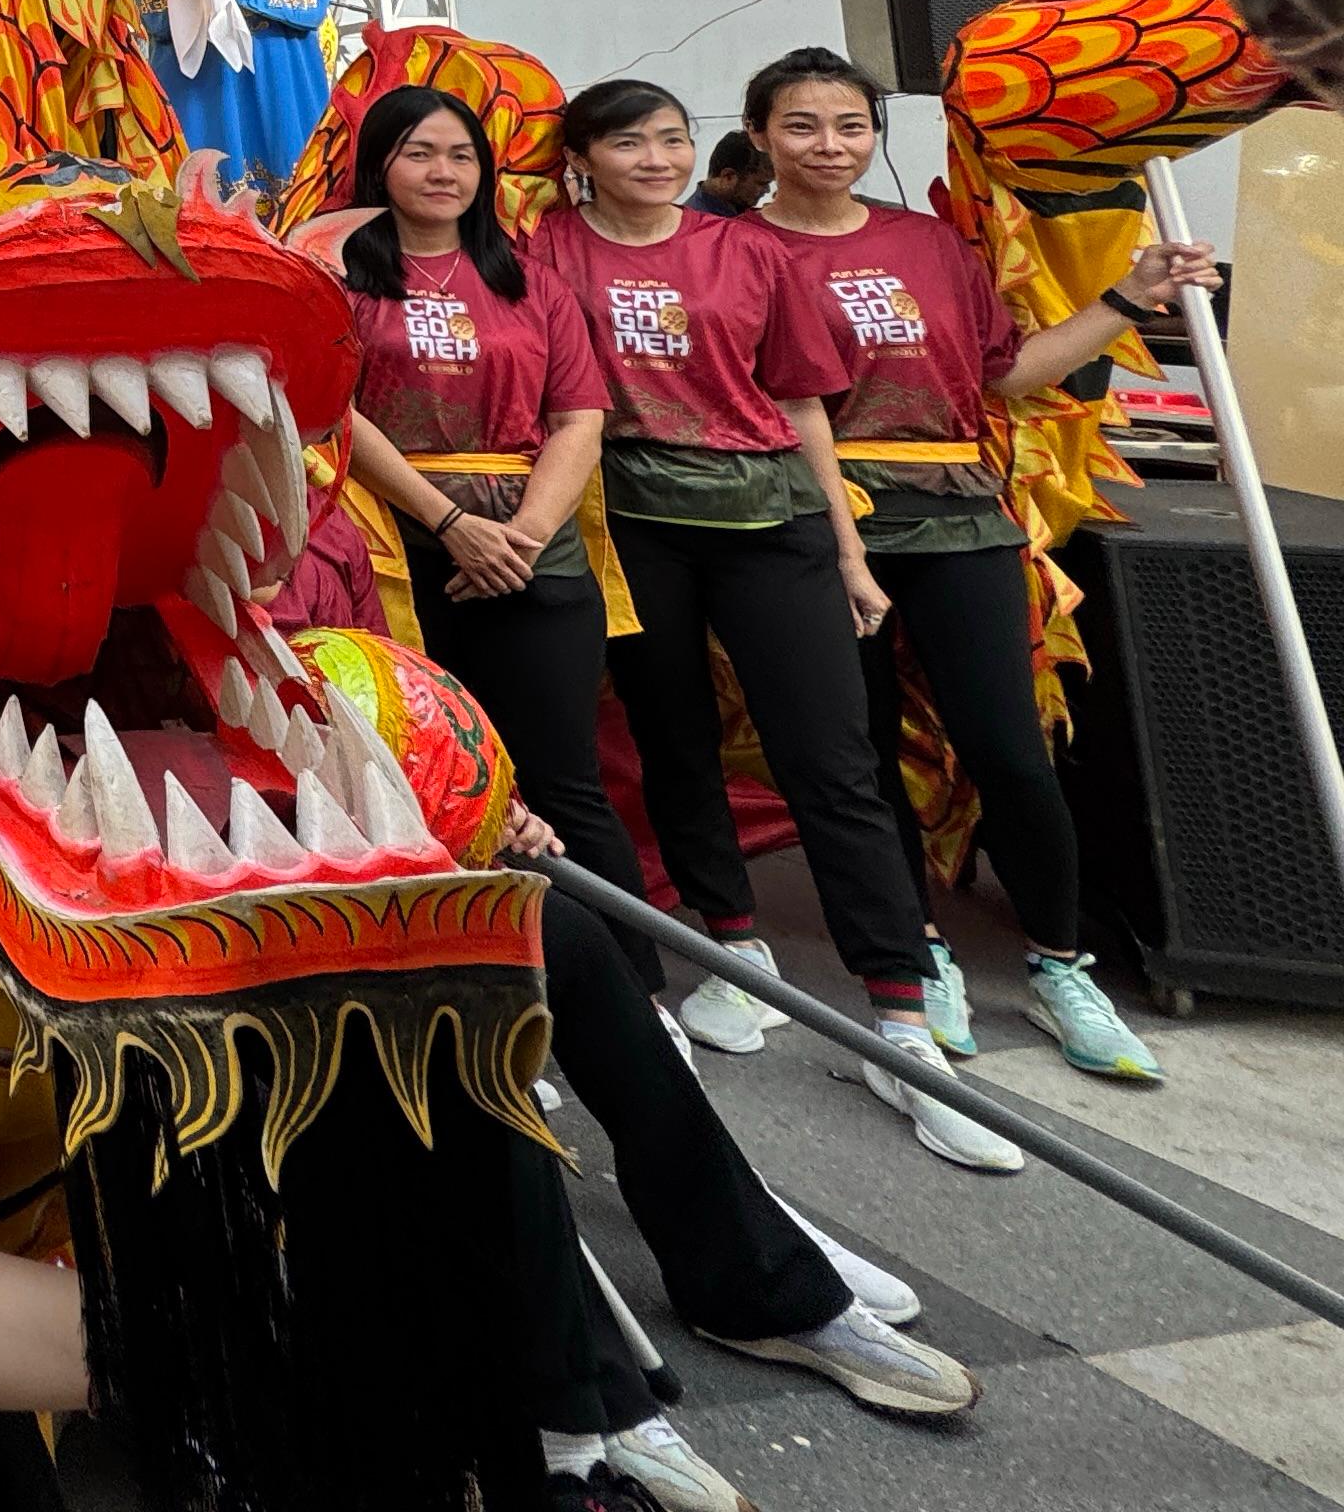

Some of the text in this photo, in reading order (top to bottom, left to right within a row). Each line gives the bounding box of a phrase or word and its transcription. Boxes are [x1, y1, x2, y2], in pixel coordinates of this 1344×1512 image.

[607, 288, 680, 310] CAP
[829, 277, 904, 300] CAP
[403, 299, 466, 319] CAP
[612, 308, 659, 332] GO
[841, 298, 895, 323] GO
[407, 316, 450, 338] GO
[853, 320, 926, 347] MEH
[409, 337, 479, 361] MEH
[614, 331, 691, 357] MEH
